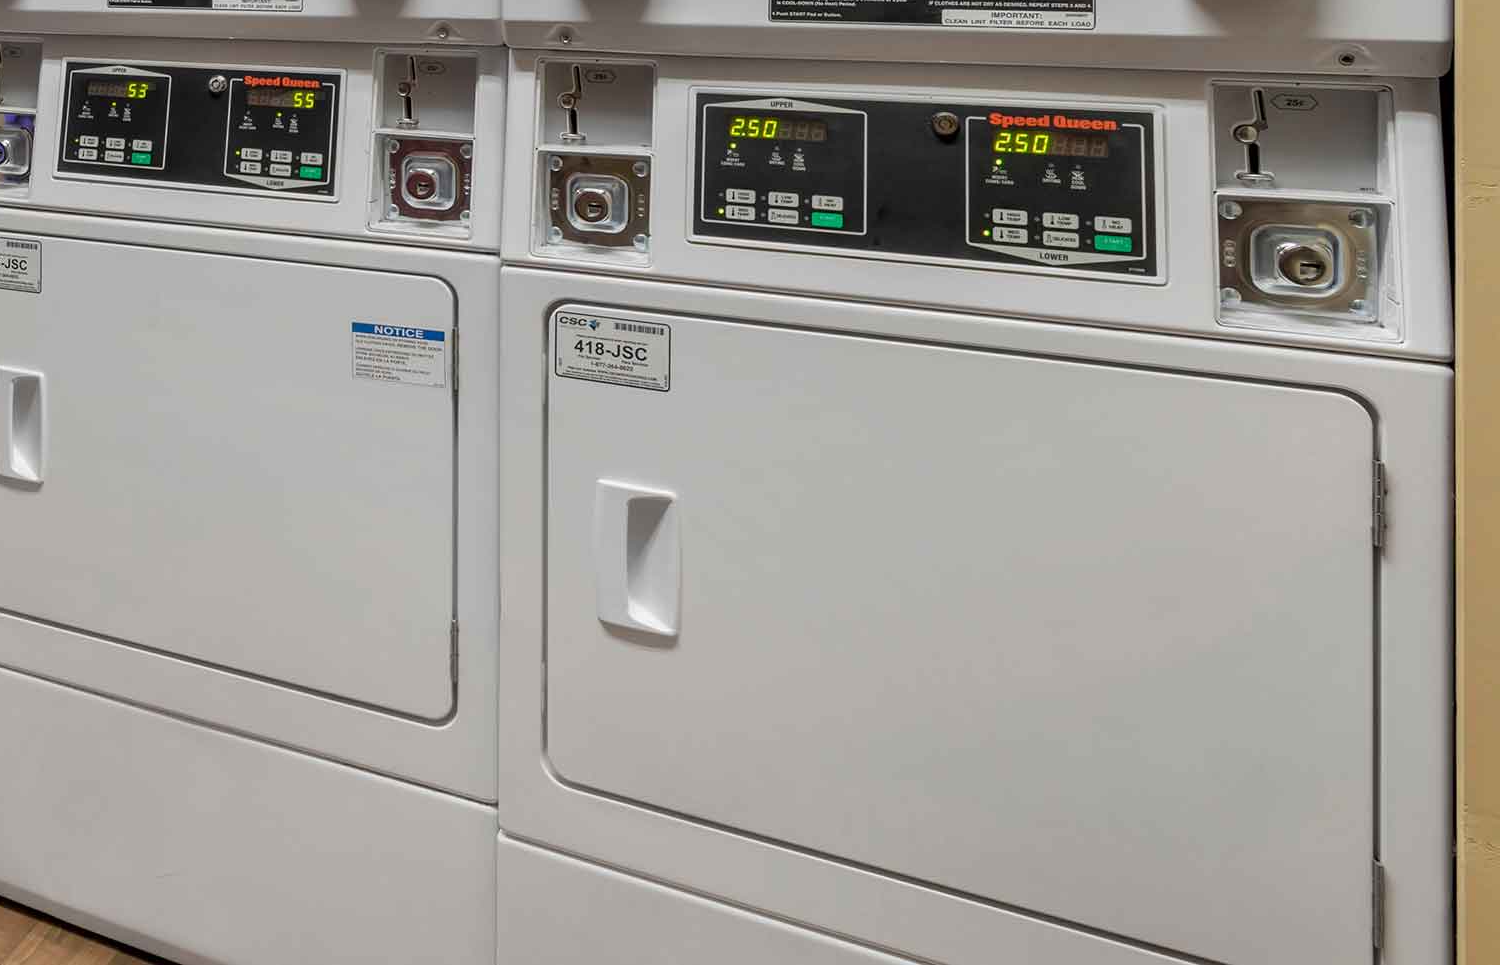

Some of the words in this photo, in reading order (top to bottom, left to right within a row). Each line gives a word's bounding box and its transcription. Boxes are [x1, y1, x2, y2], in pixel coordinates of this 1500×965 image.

[991, 11, 1043, 19] IMPORTANT:
[243, 76, 281, 88] Speed
[282, 77, 322, 89] Queen
[128, 83, 150, 99] 53
[293, 92, 316, 109] 55
[770, 100, 793, 110] UPPER
[730, 117, 779, 139] 2.50
[988, 112, 1051, 128] Speed
[1052, 115, 1118, 131] Queen
[994, 131, 1051, 154] 2.50
[1039, 252, 1069, 262] LOWER
[559, 316, 588, 327] CSC
[373, 324, 425, 339] NOTICE
[574, 339, 648, 362] 418-JSC
